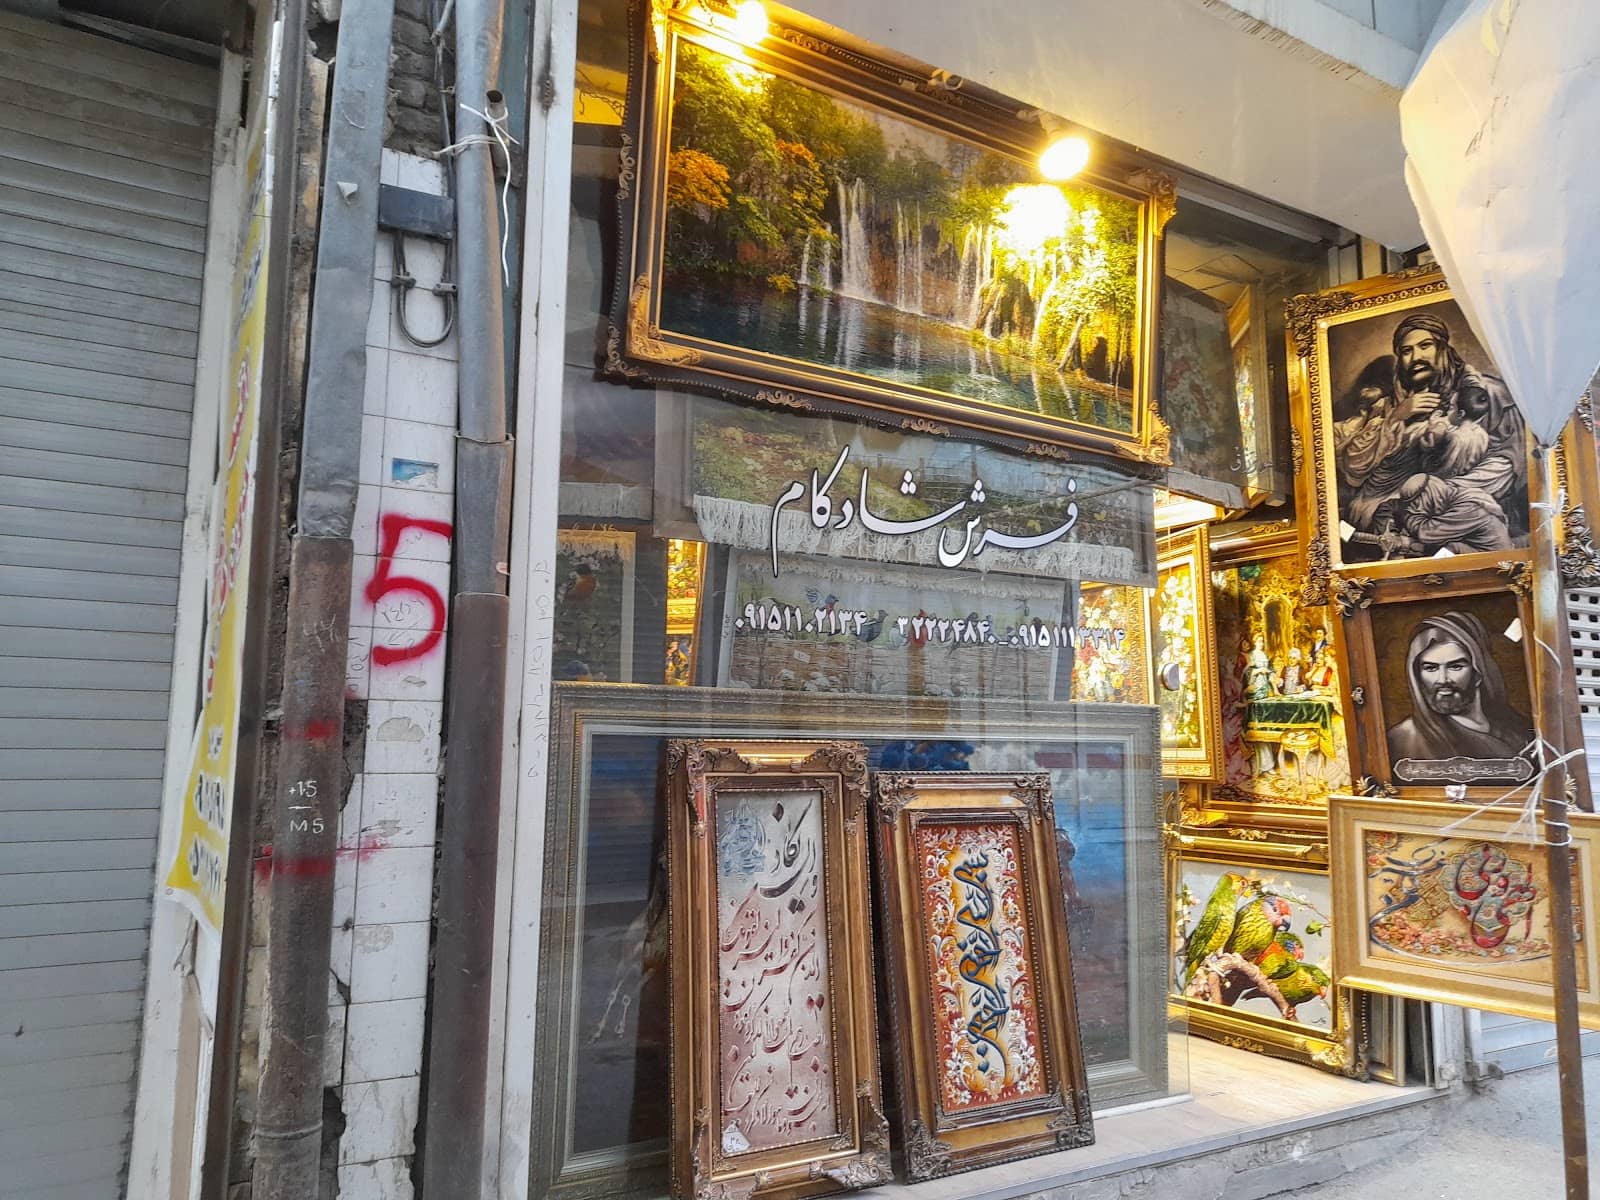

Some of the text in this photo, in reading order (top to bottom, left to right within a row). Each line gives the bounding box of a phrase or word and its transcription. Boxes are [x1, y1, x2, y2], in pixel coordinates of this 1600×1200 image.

[771, 444, 1079, 578] فرش شادکام
[366, 513, 453, 666] 5
